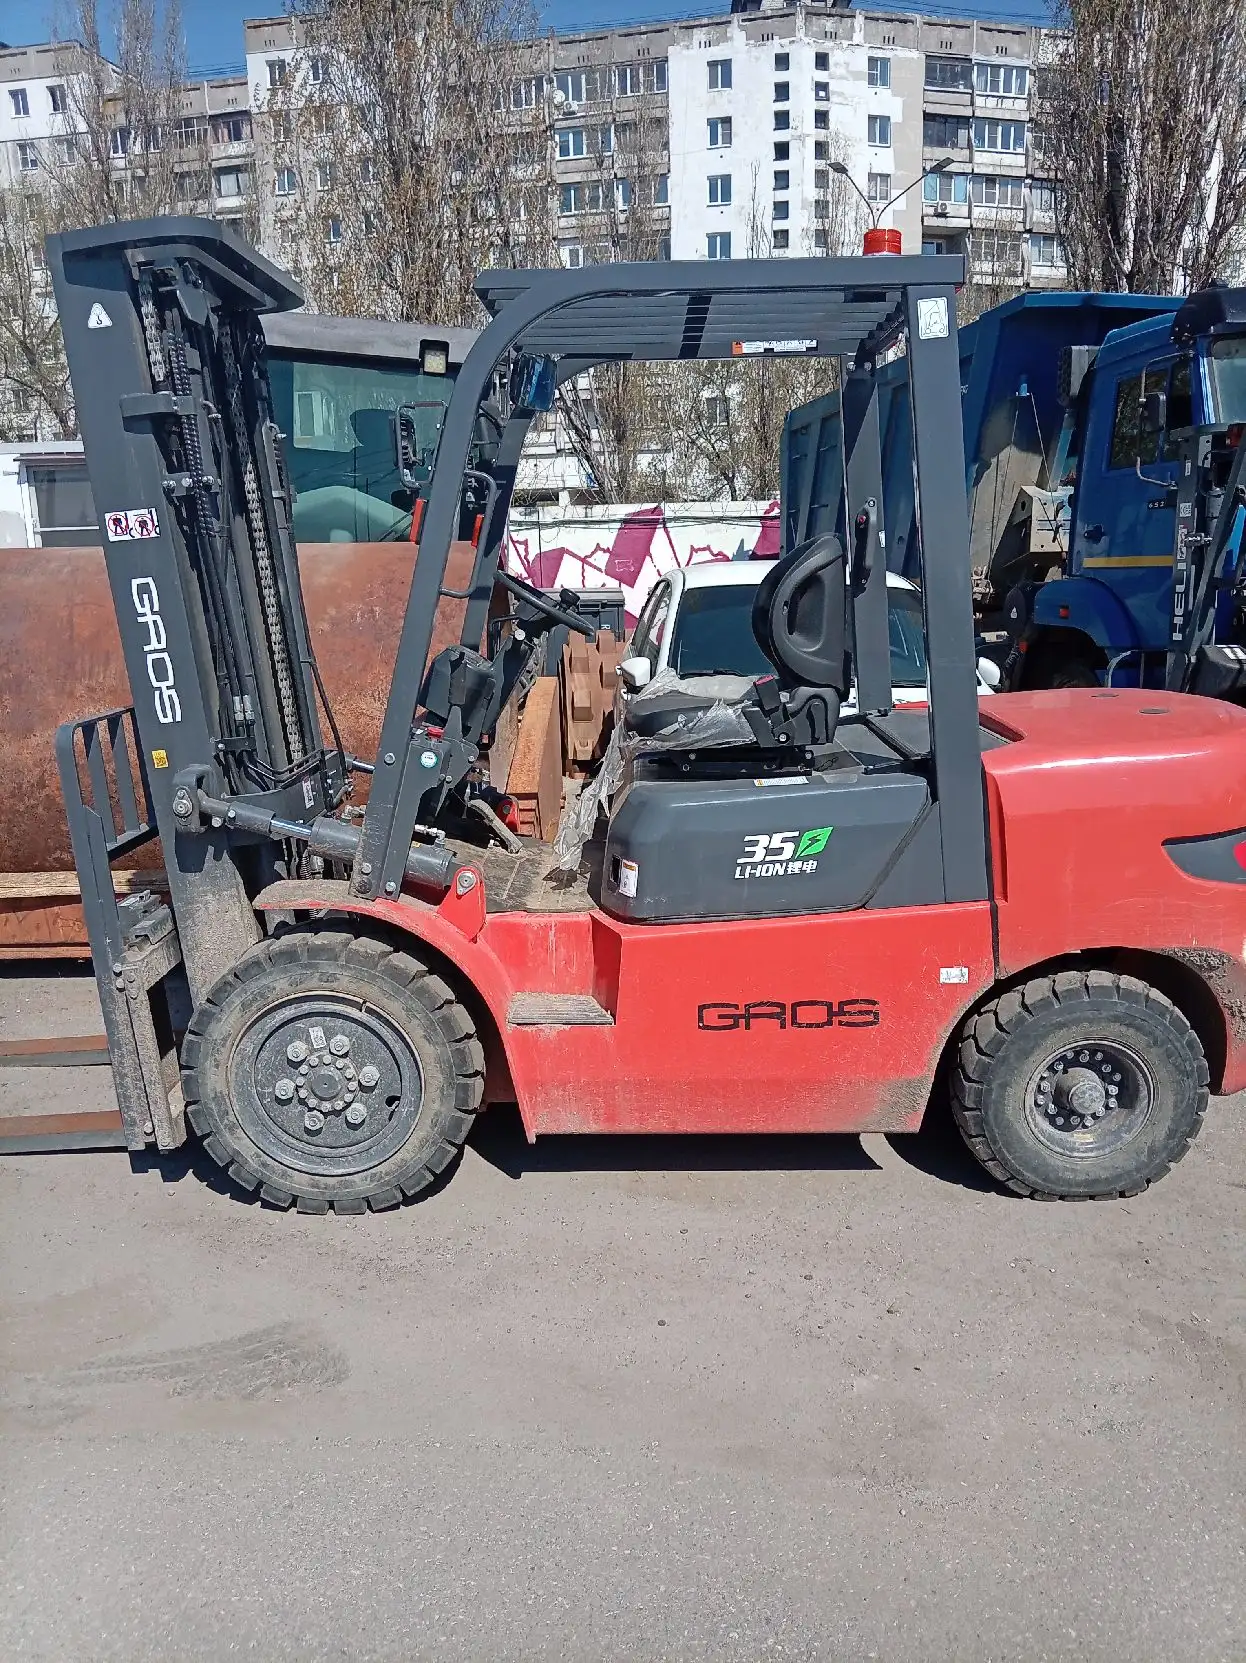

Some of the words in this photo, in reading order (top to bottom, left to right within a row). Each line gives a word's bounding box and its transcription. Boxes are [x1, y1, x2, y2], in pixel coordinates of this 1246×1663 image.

[1172, 562, 1187, 641] HELI
[736, 831, 800, 864] 35
[734, 862, 786, 879] LI-ION
